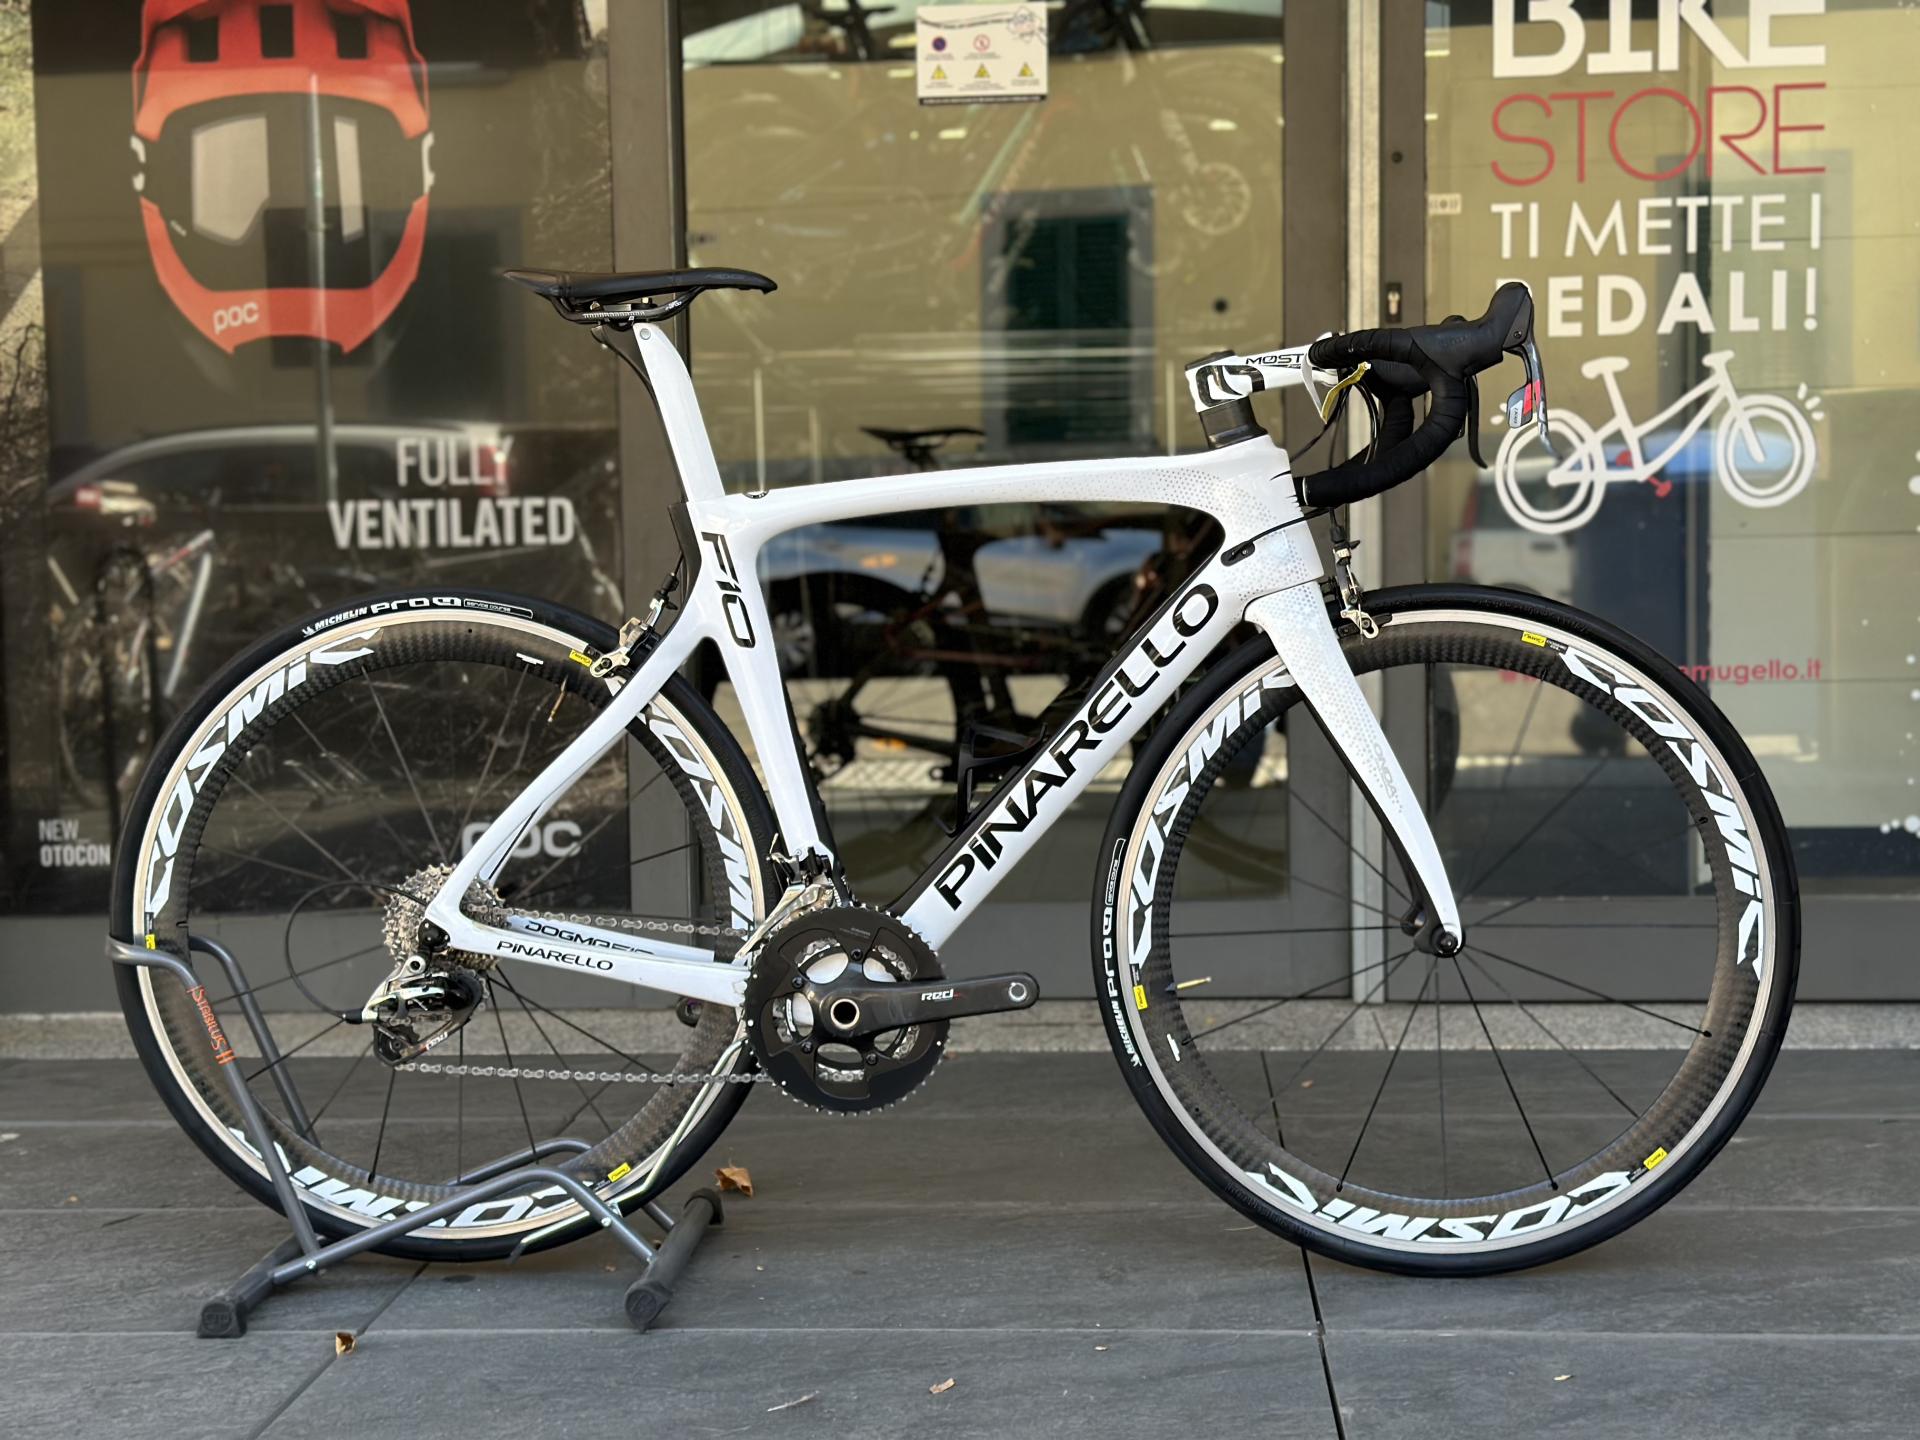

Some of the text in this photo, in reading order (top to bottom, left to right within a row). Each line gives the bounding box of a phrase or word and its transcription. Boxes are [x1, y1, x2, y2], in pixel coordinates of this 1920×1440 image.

[1493, 0, 1826, 78] BIKE
[1491, 82, 1827, 187] STORE
[1491, 192, 1822, 260] TI METTE I
[1496, 267, 1818, 338] EDALI!
[1245, 353, 1305, 365] MOST
[396, 434, 513, 488] FULLY
[327, 498, 576, 549] VENTILATED
[314, 606, 368, 631] MICHELIN
[934, 583, 1219, 911] PINARELLO
[38, 818, 80, 842] NEW
[40, 843, 111, 867] OTOCON
[496, 940, 614, 971] PINARELLO
[1111, 1000, 1136, 1055] MICHELIN
